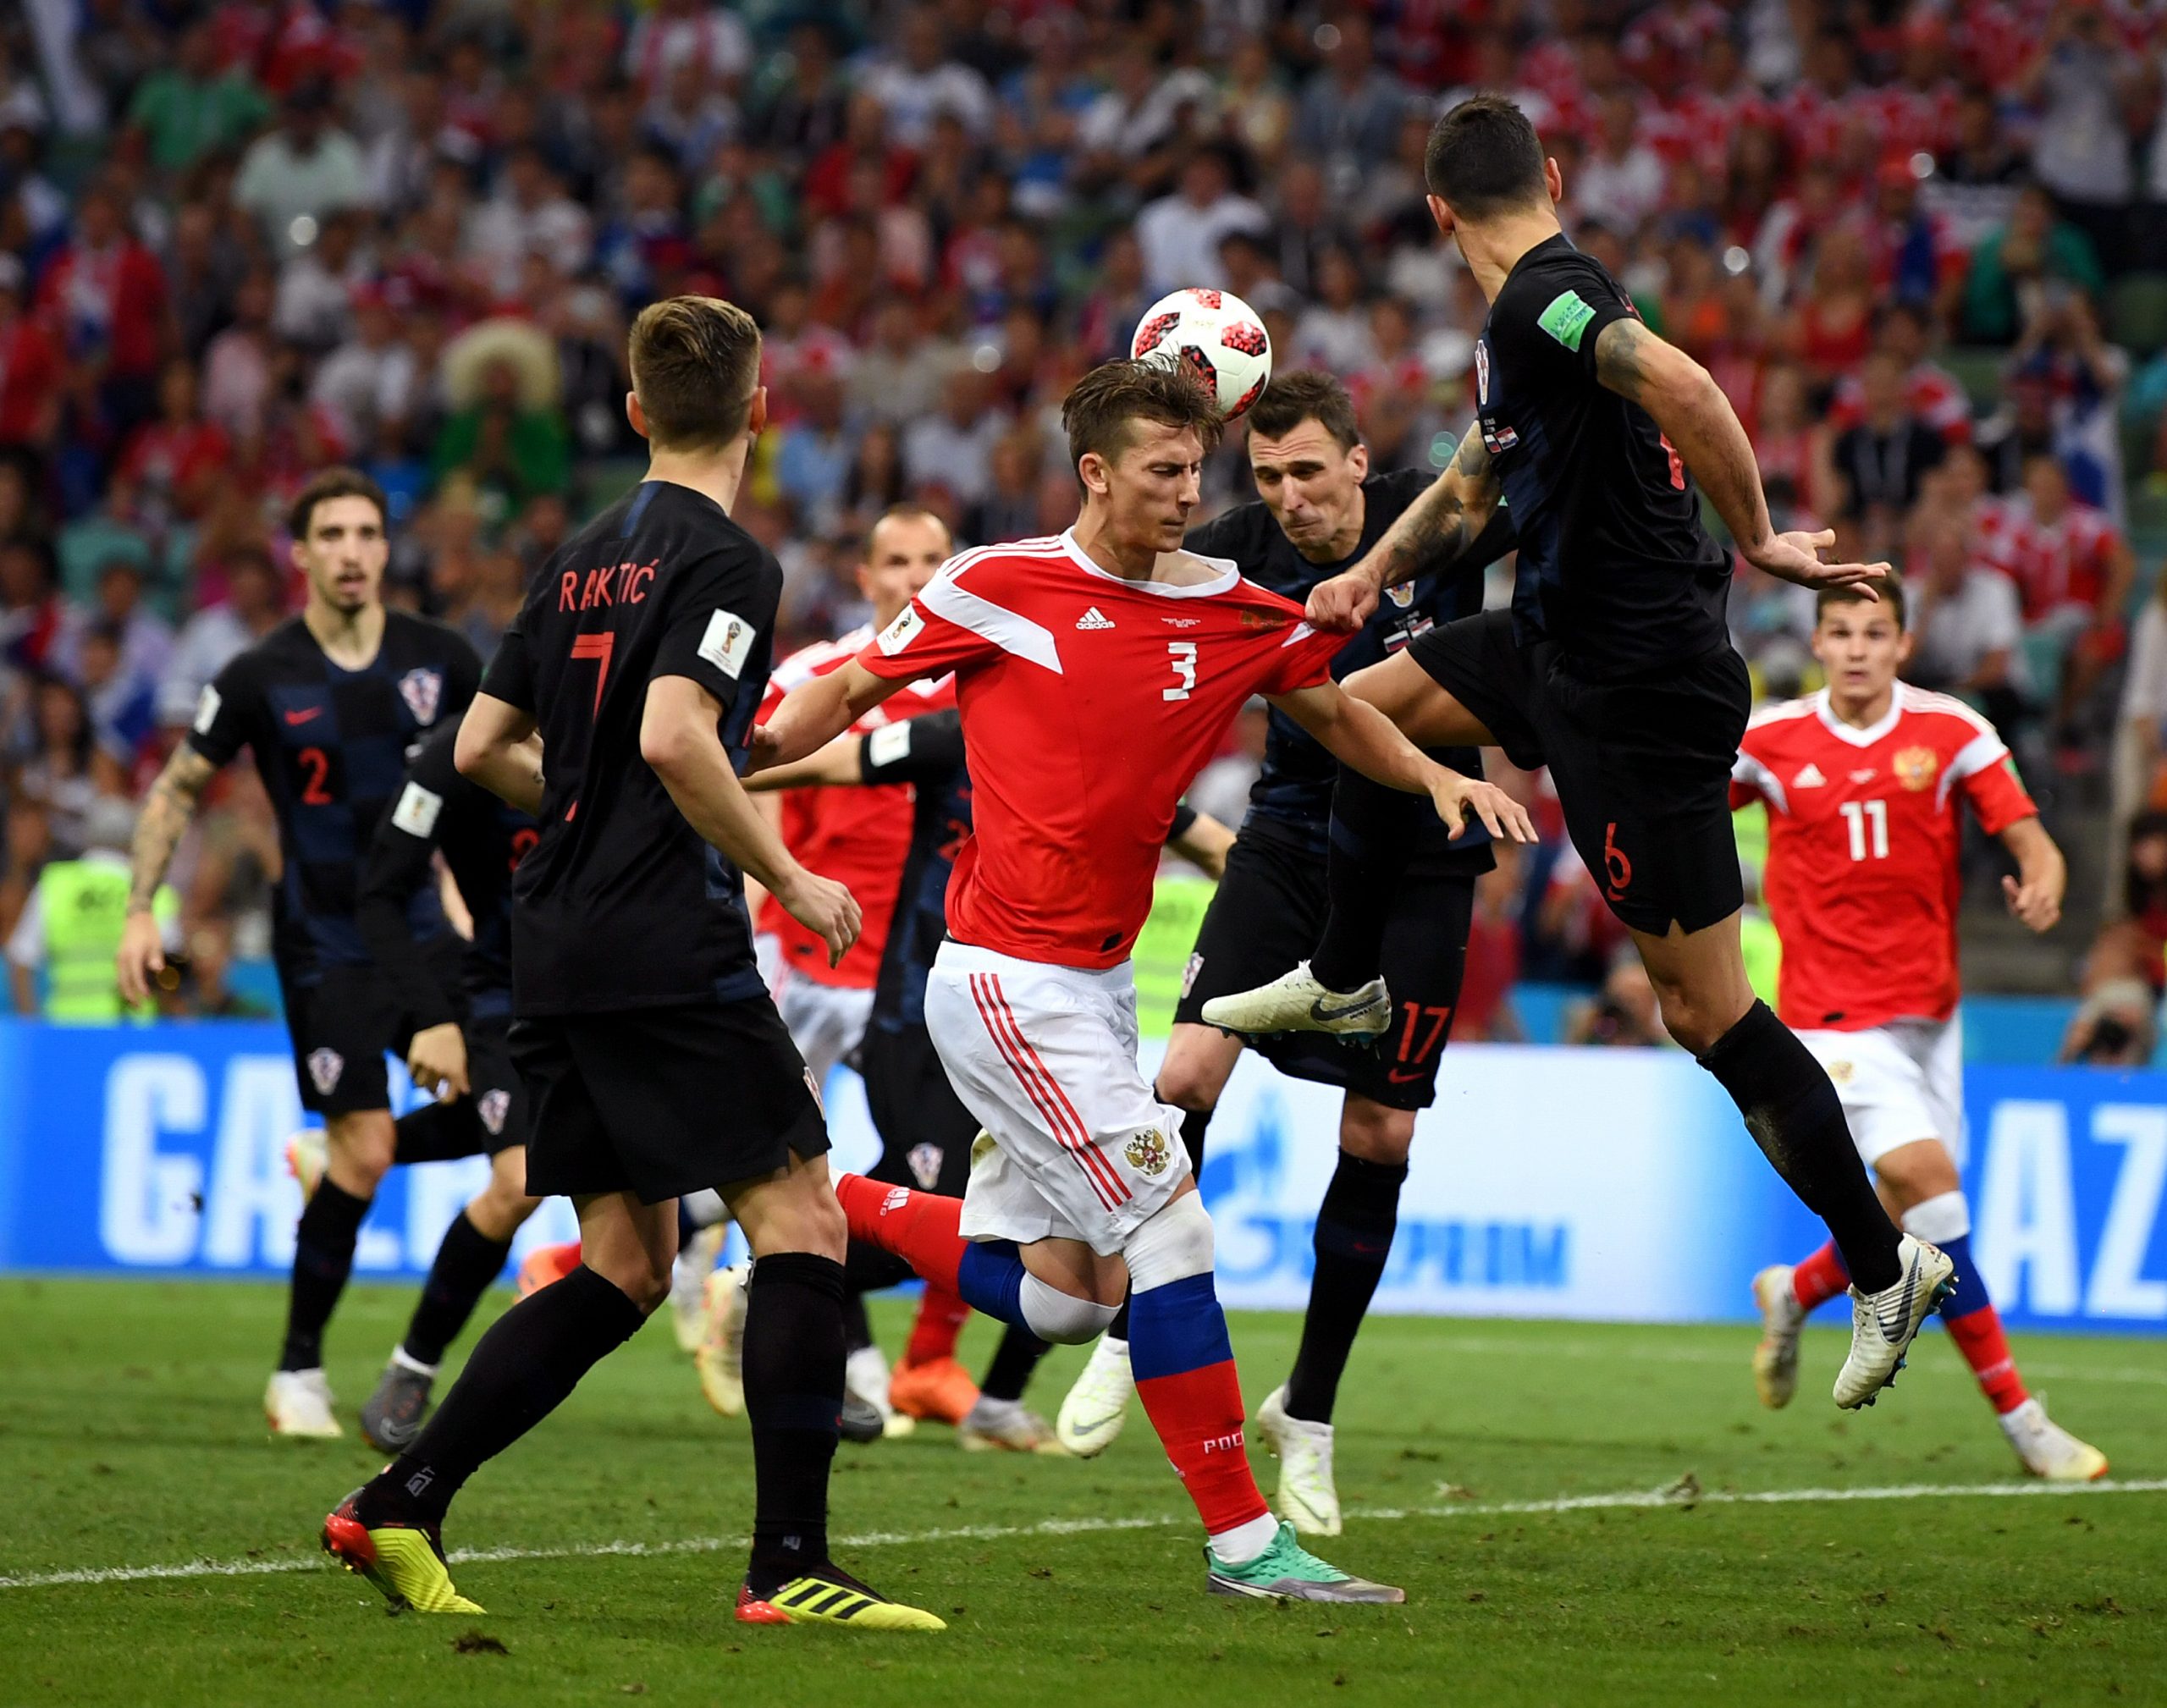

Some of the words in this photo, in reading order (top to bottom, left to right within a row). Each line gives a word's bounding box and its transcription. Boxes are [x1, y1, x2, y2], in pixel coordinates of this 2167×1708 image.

[1075, 620, 1116, 630] adidas
[571, 631, 615, 722] 7
[1162, 642, 1197, 702] 3
[298, 747, 334, 806] 2
[1605, 822, 1631, 889] 6
[1839, 799, 1889, 862] 11
[1398, 1001, 1450, 1064] 17
[1957, 1098, 2167, 1319] AZ
